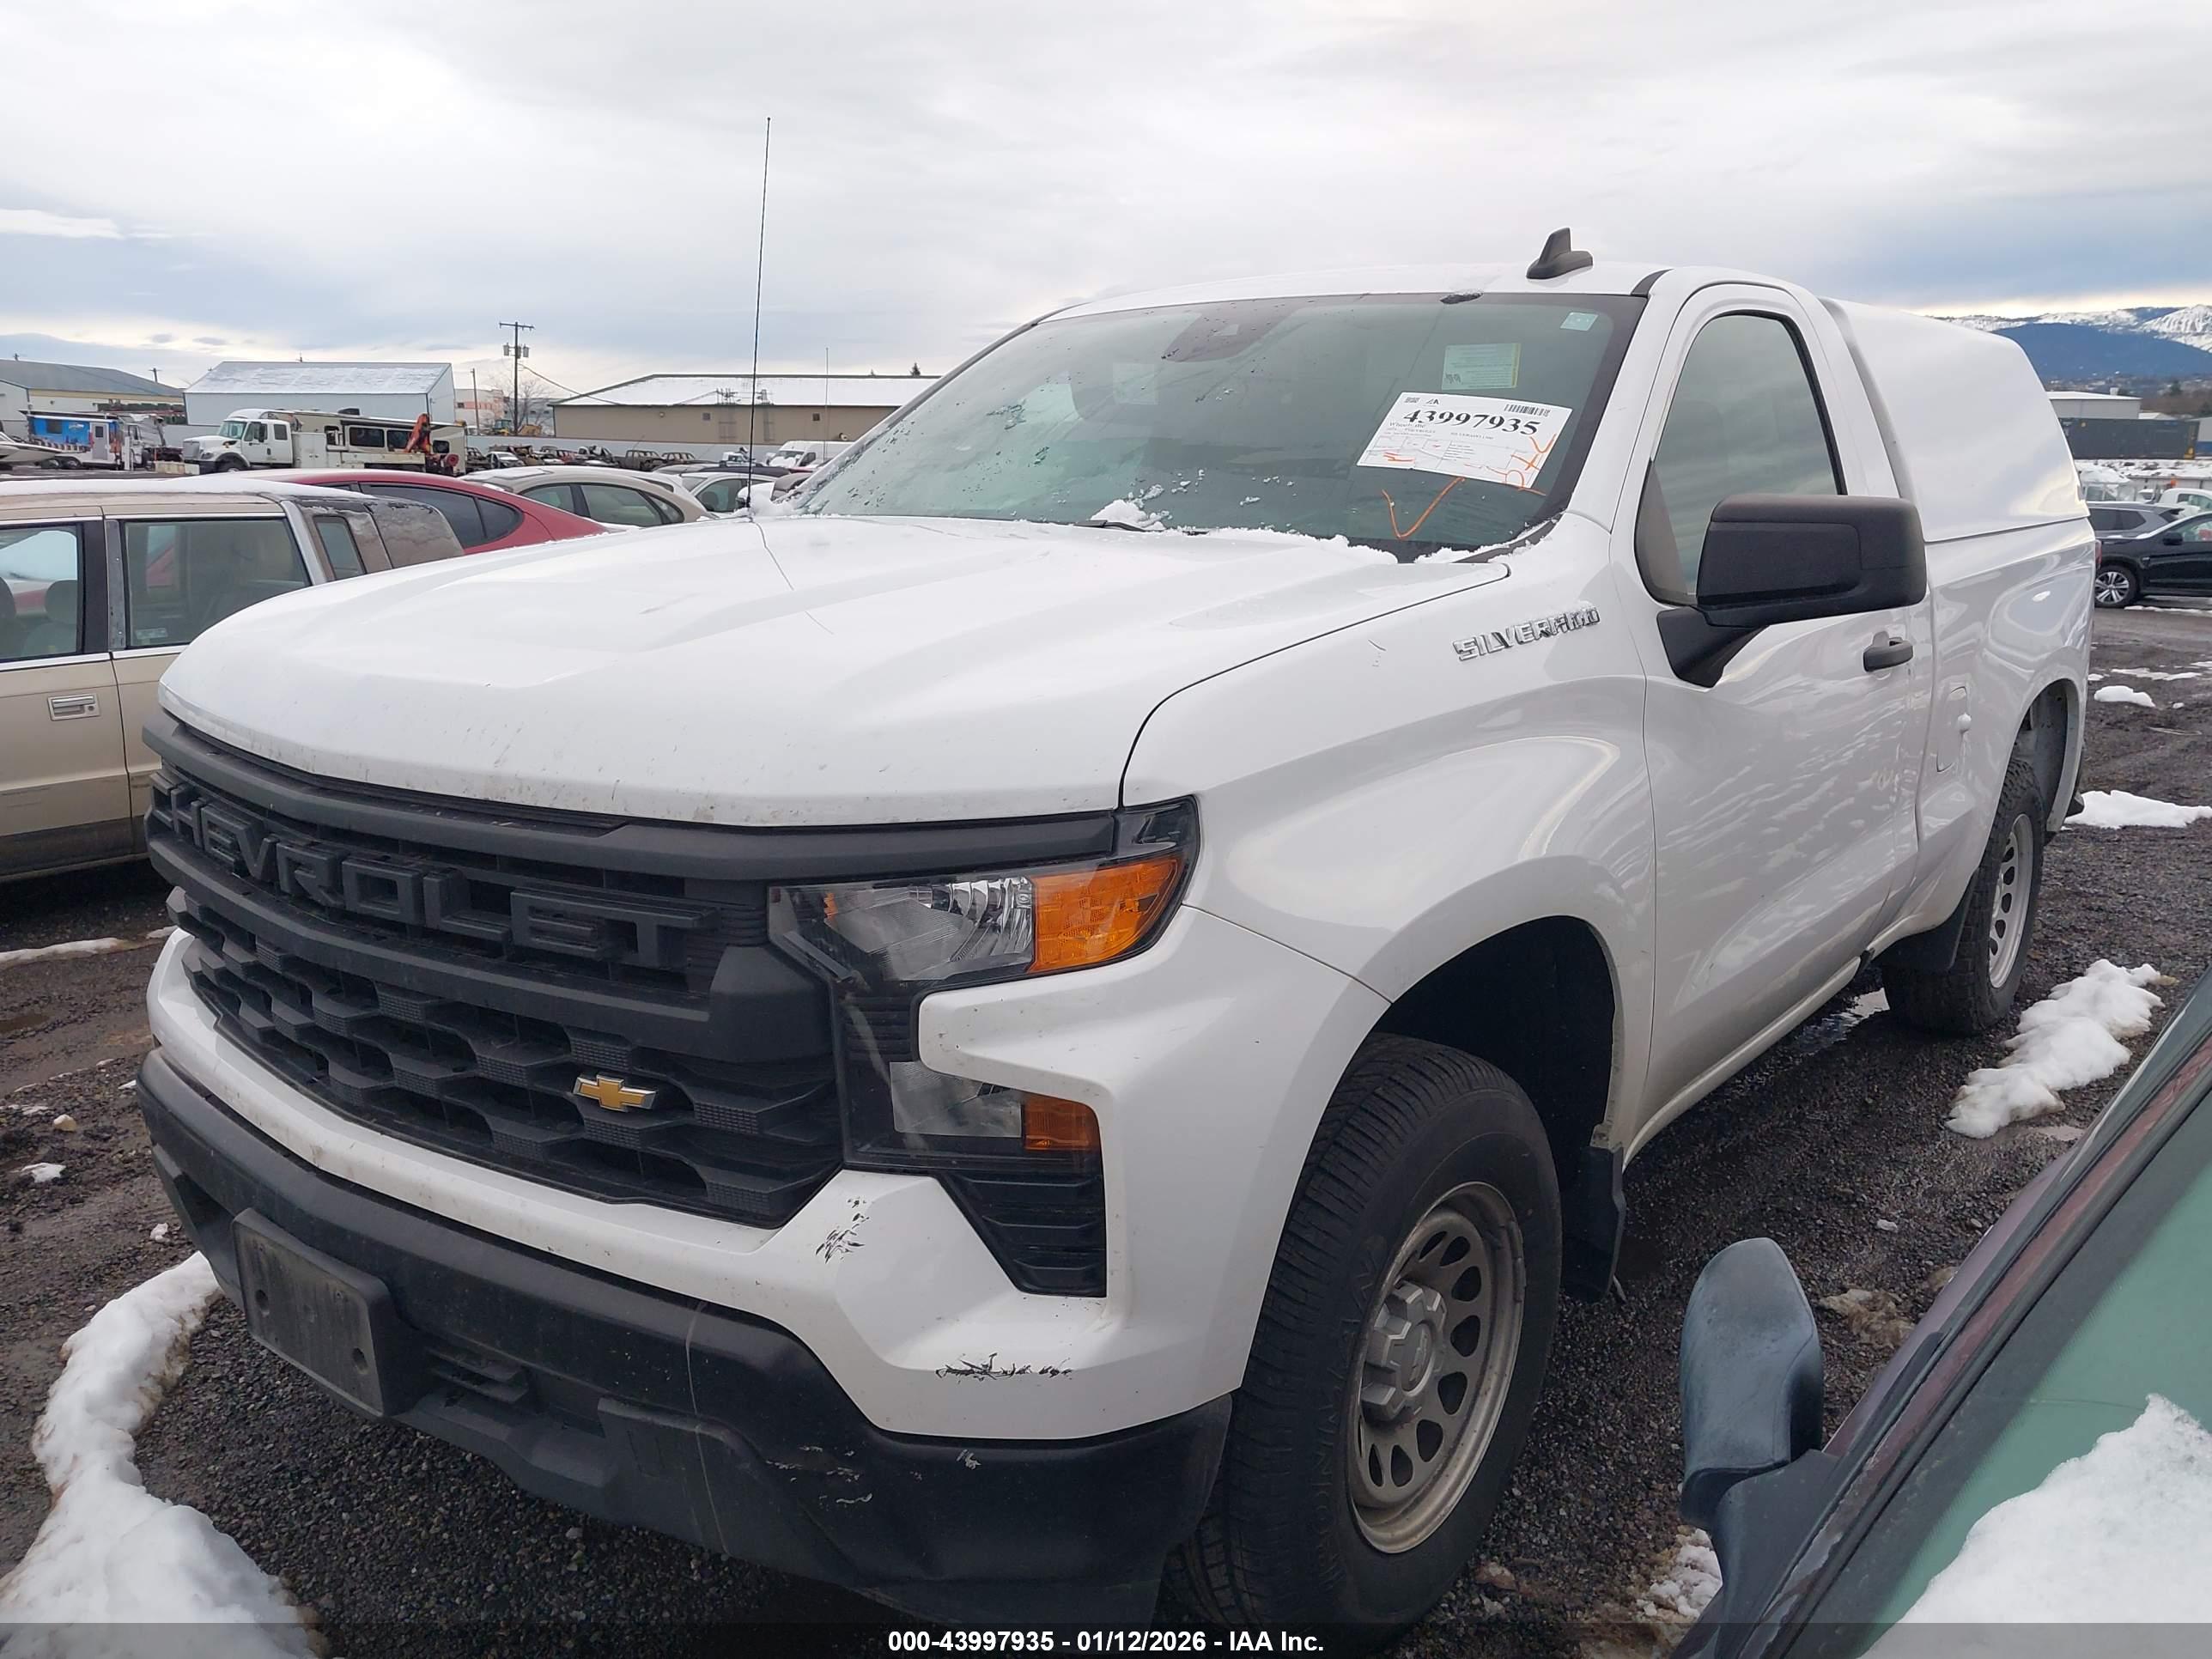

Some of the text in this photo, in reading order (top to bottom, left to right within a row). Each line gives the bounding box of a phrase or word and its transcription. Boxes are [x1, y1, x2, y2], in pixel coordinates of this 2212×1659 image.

[1403, 410, 1541, 435] 43997935
[1453, 606, 1601, 661] SILVERADO
[150, 771, 718, 968] CHEVROLET
